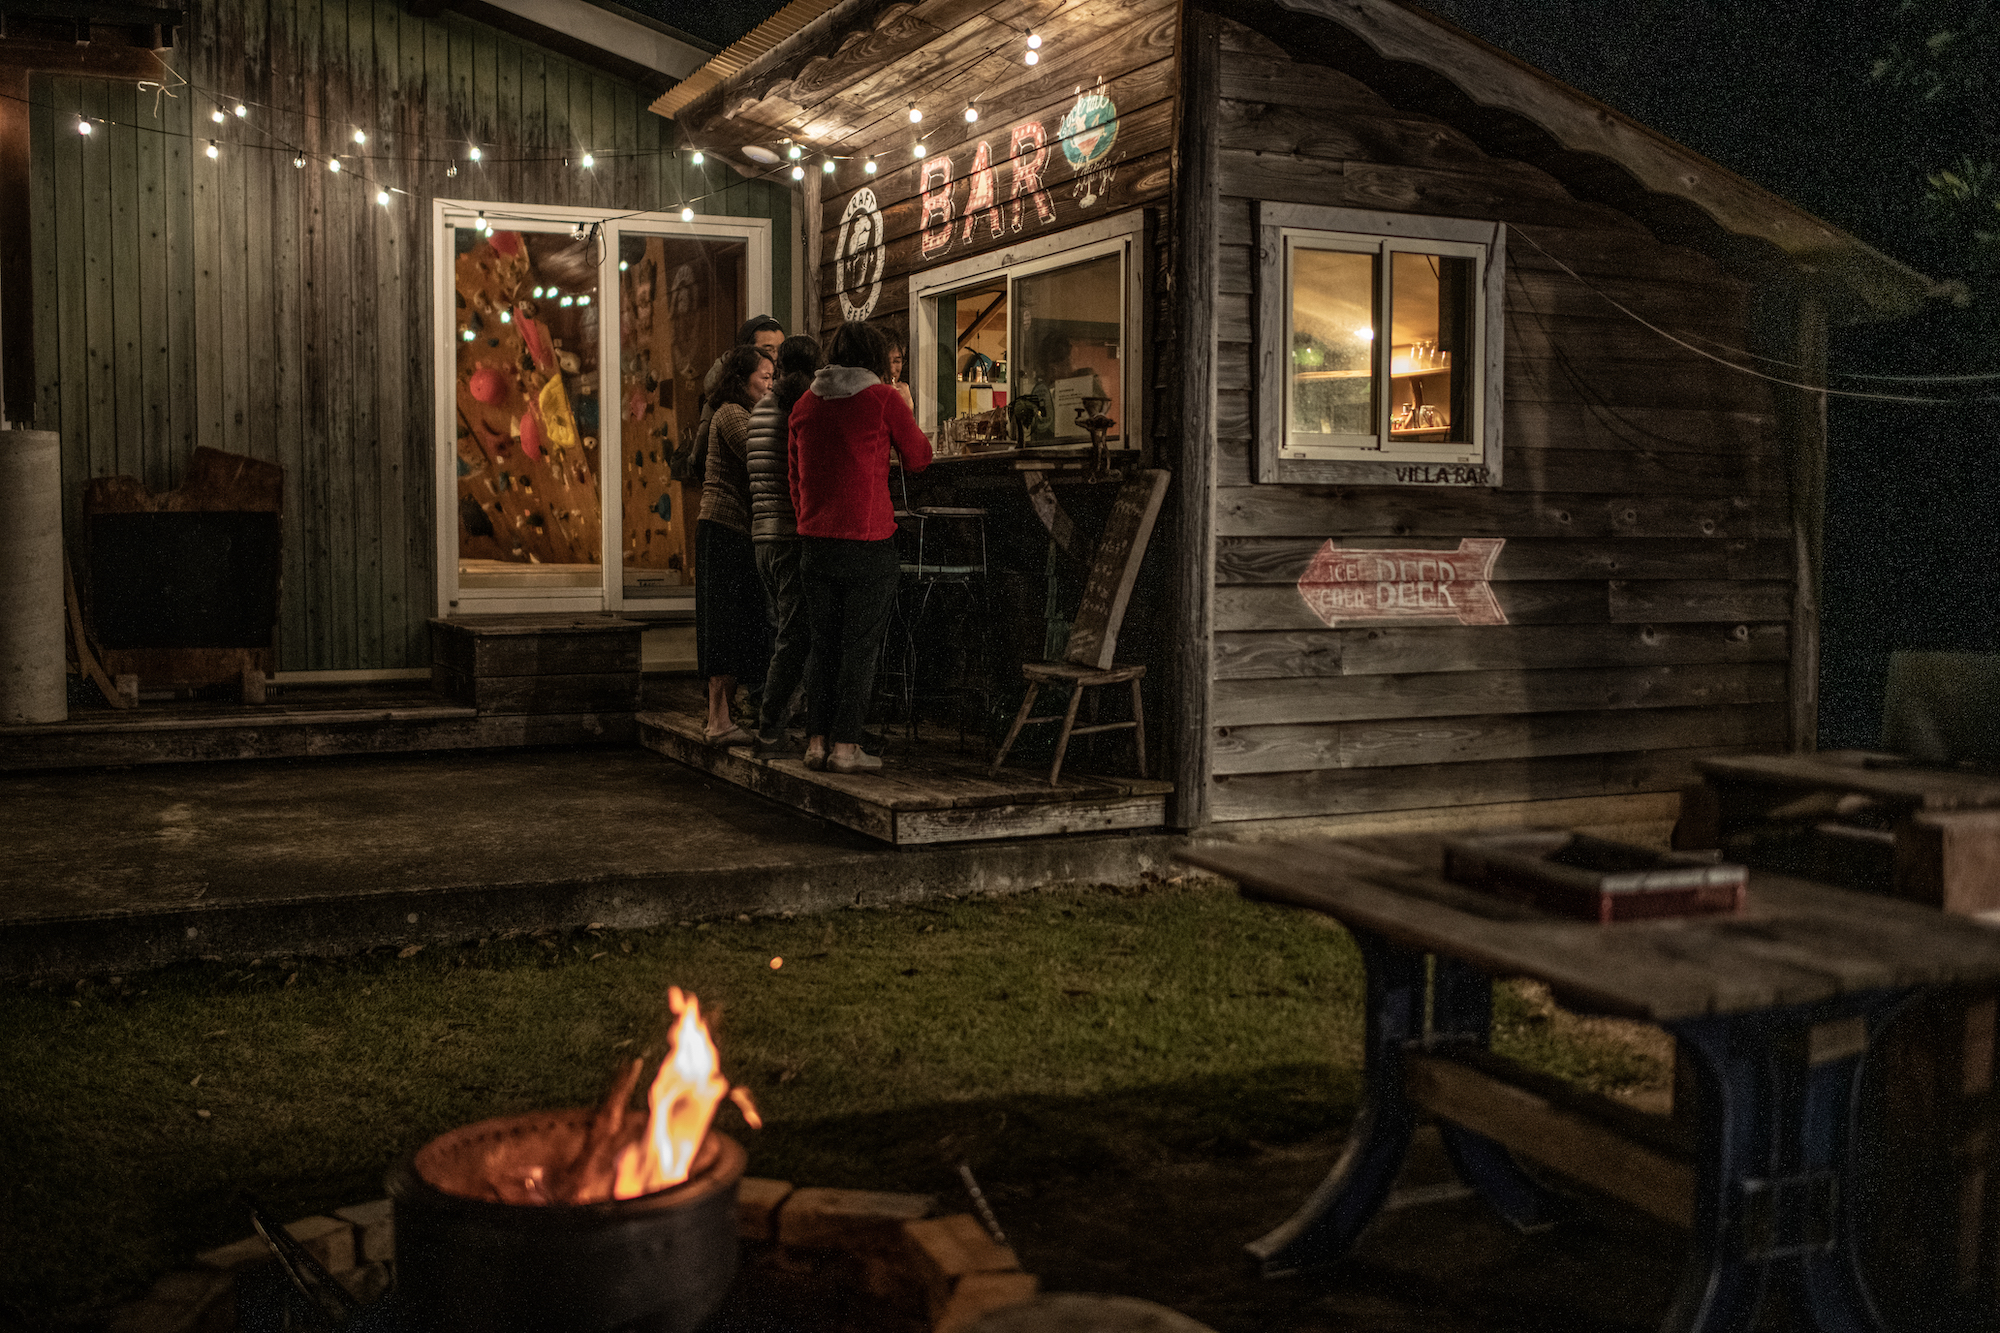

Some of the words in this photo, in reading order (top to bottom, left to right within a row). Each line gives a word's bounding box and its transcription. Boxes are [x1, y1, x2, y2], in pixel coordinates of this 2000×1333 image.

[919, 120, 1056, 262] BAR
[847, 191, 875, 217] CRAFT
[846, 301, 870, 320] BEER
[1395, 466, 1449, 483] VILLA
[1454, 466, 1490, 484] BAR
[1327, 564, 1358, 582] ICE
[1376, 558, 1457, 609] BEER
